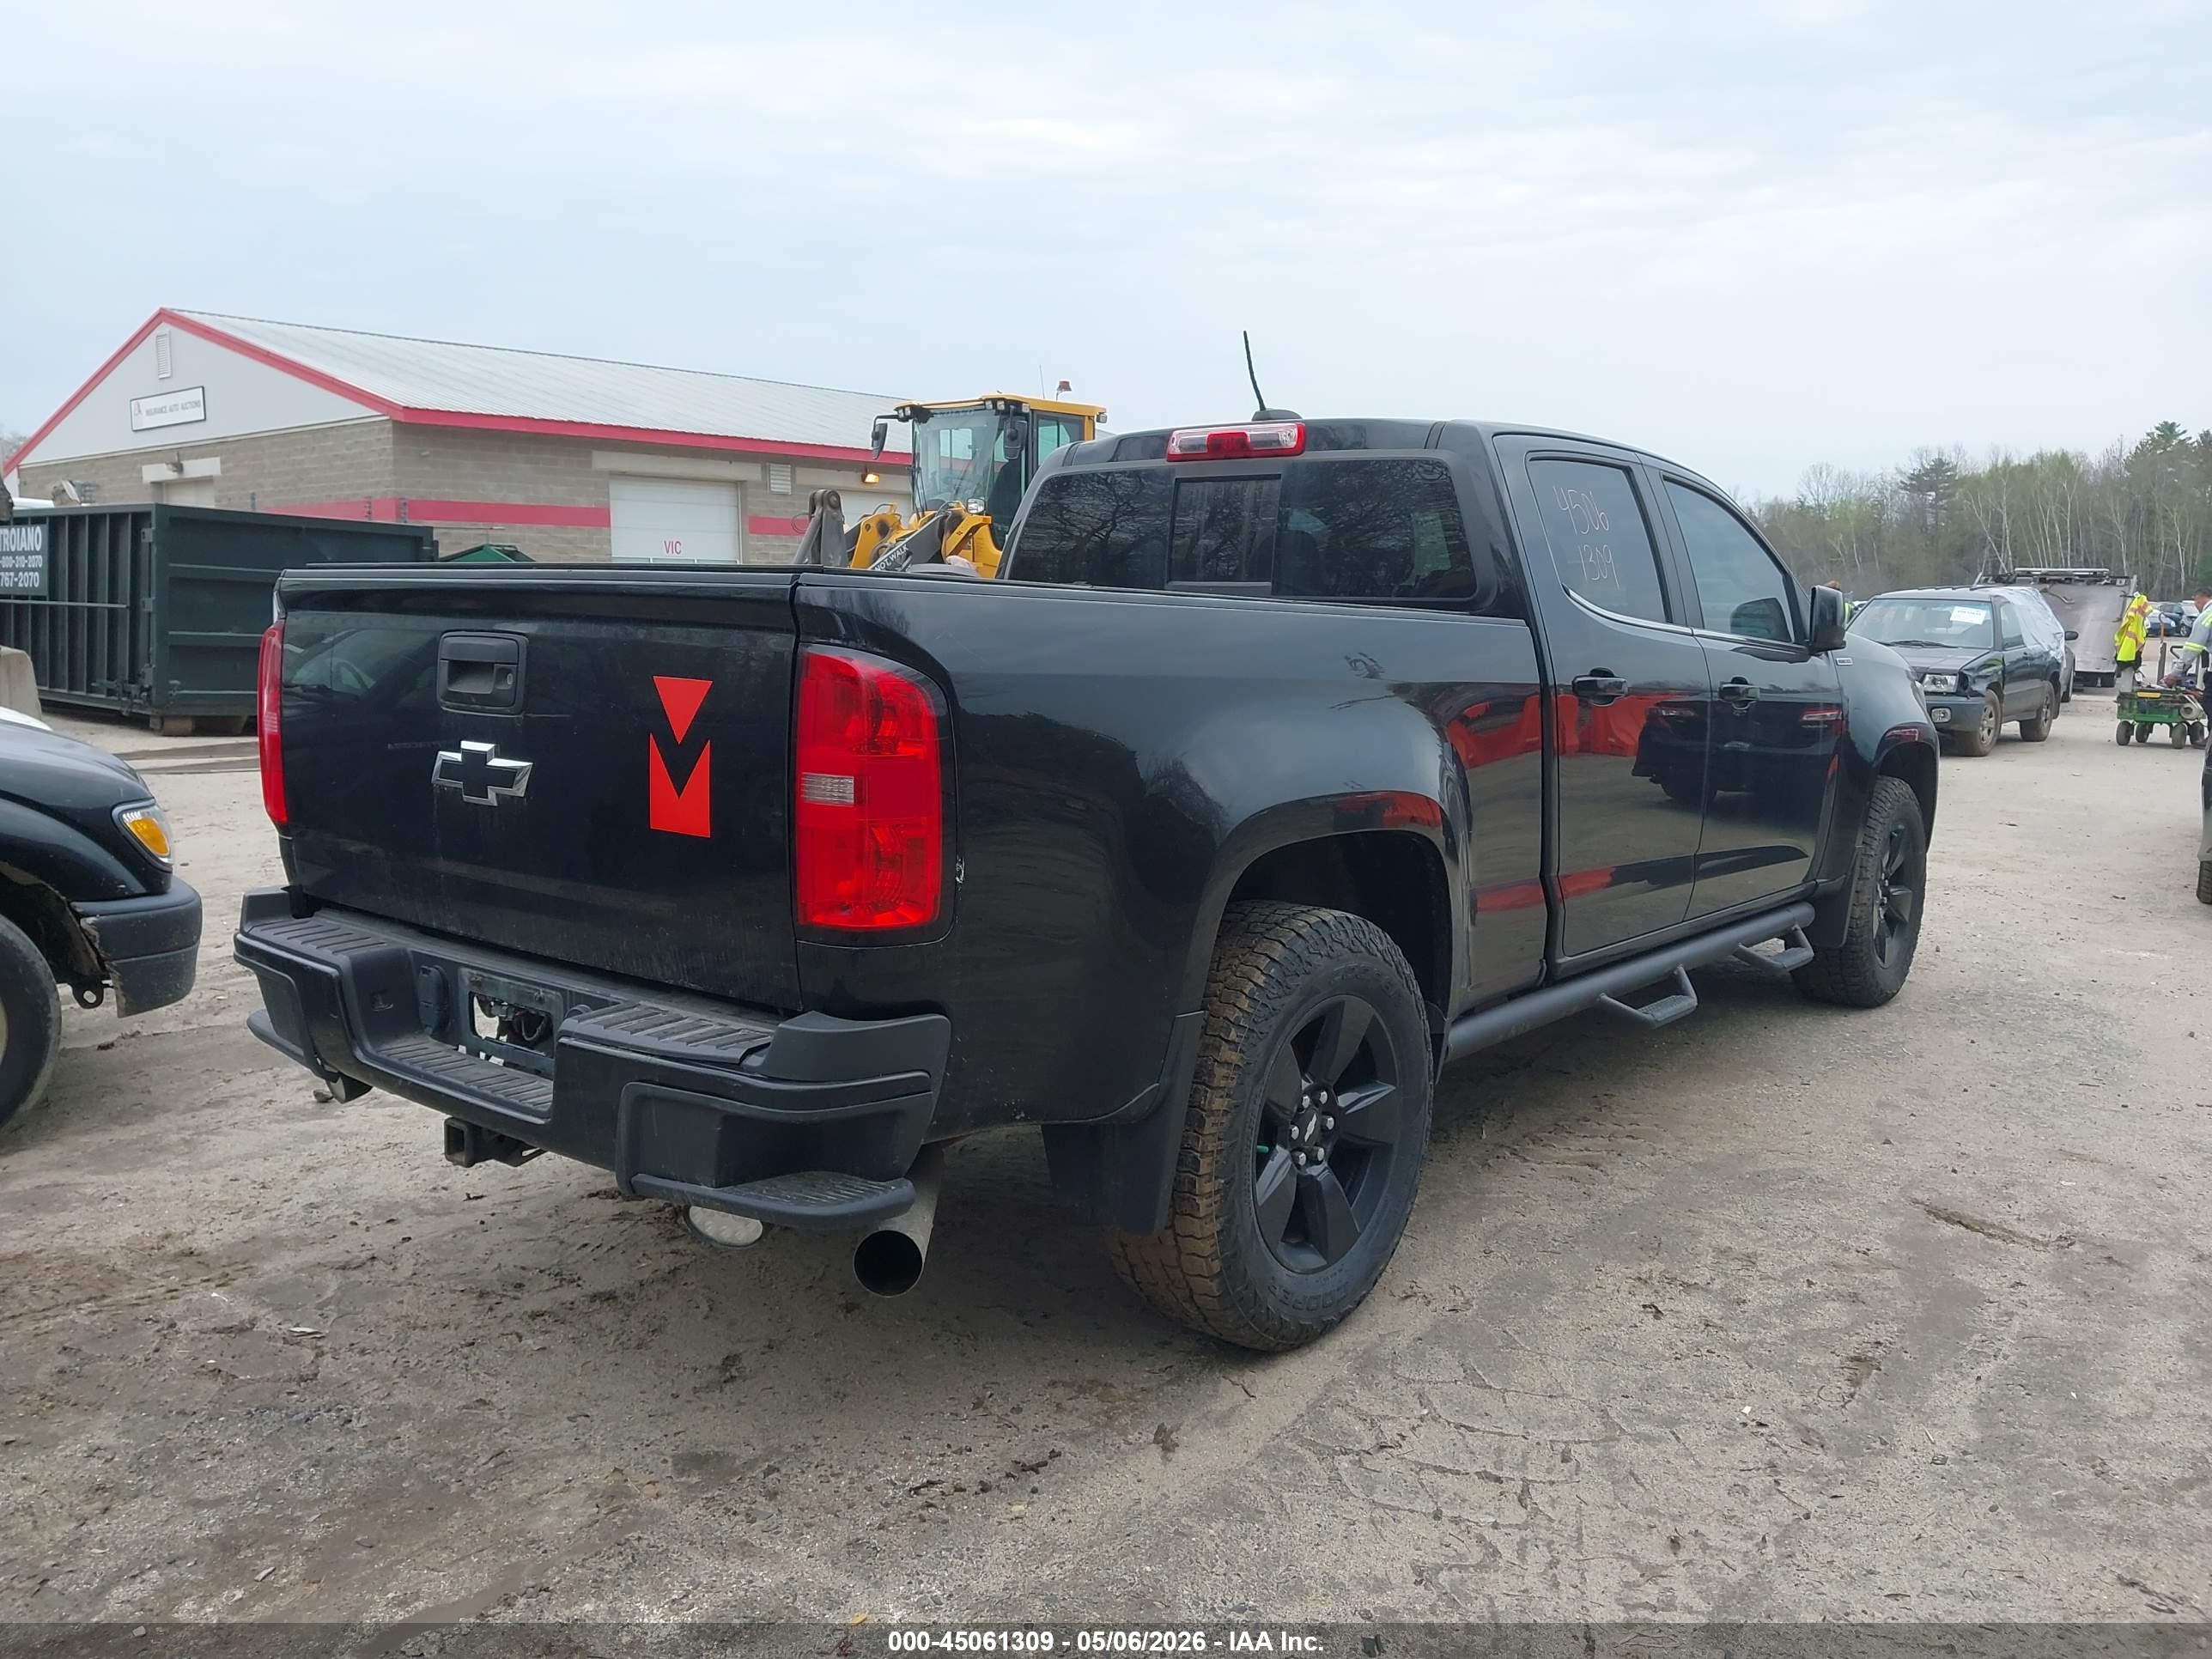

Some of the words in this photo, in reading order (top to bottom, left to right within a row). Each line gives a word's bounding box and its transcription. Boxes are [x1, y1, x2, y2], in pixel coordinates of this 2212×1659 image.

[1552, 484, 1609, 536] 4506
[0, 526, 42, 552] TROIANO
[663, 540, 682, 555] VIC
[889, 543, 909, 561] WALK
[1577, 544, 1620, 590] 1309
